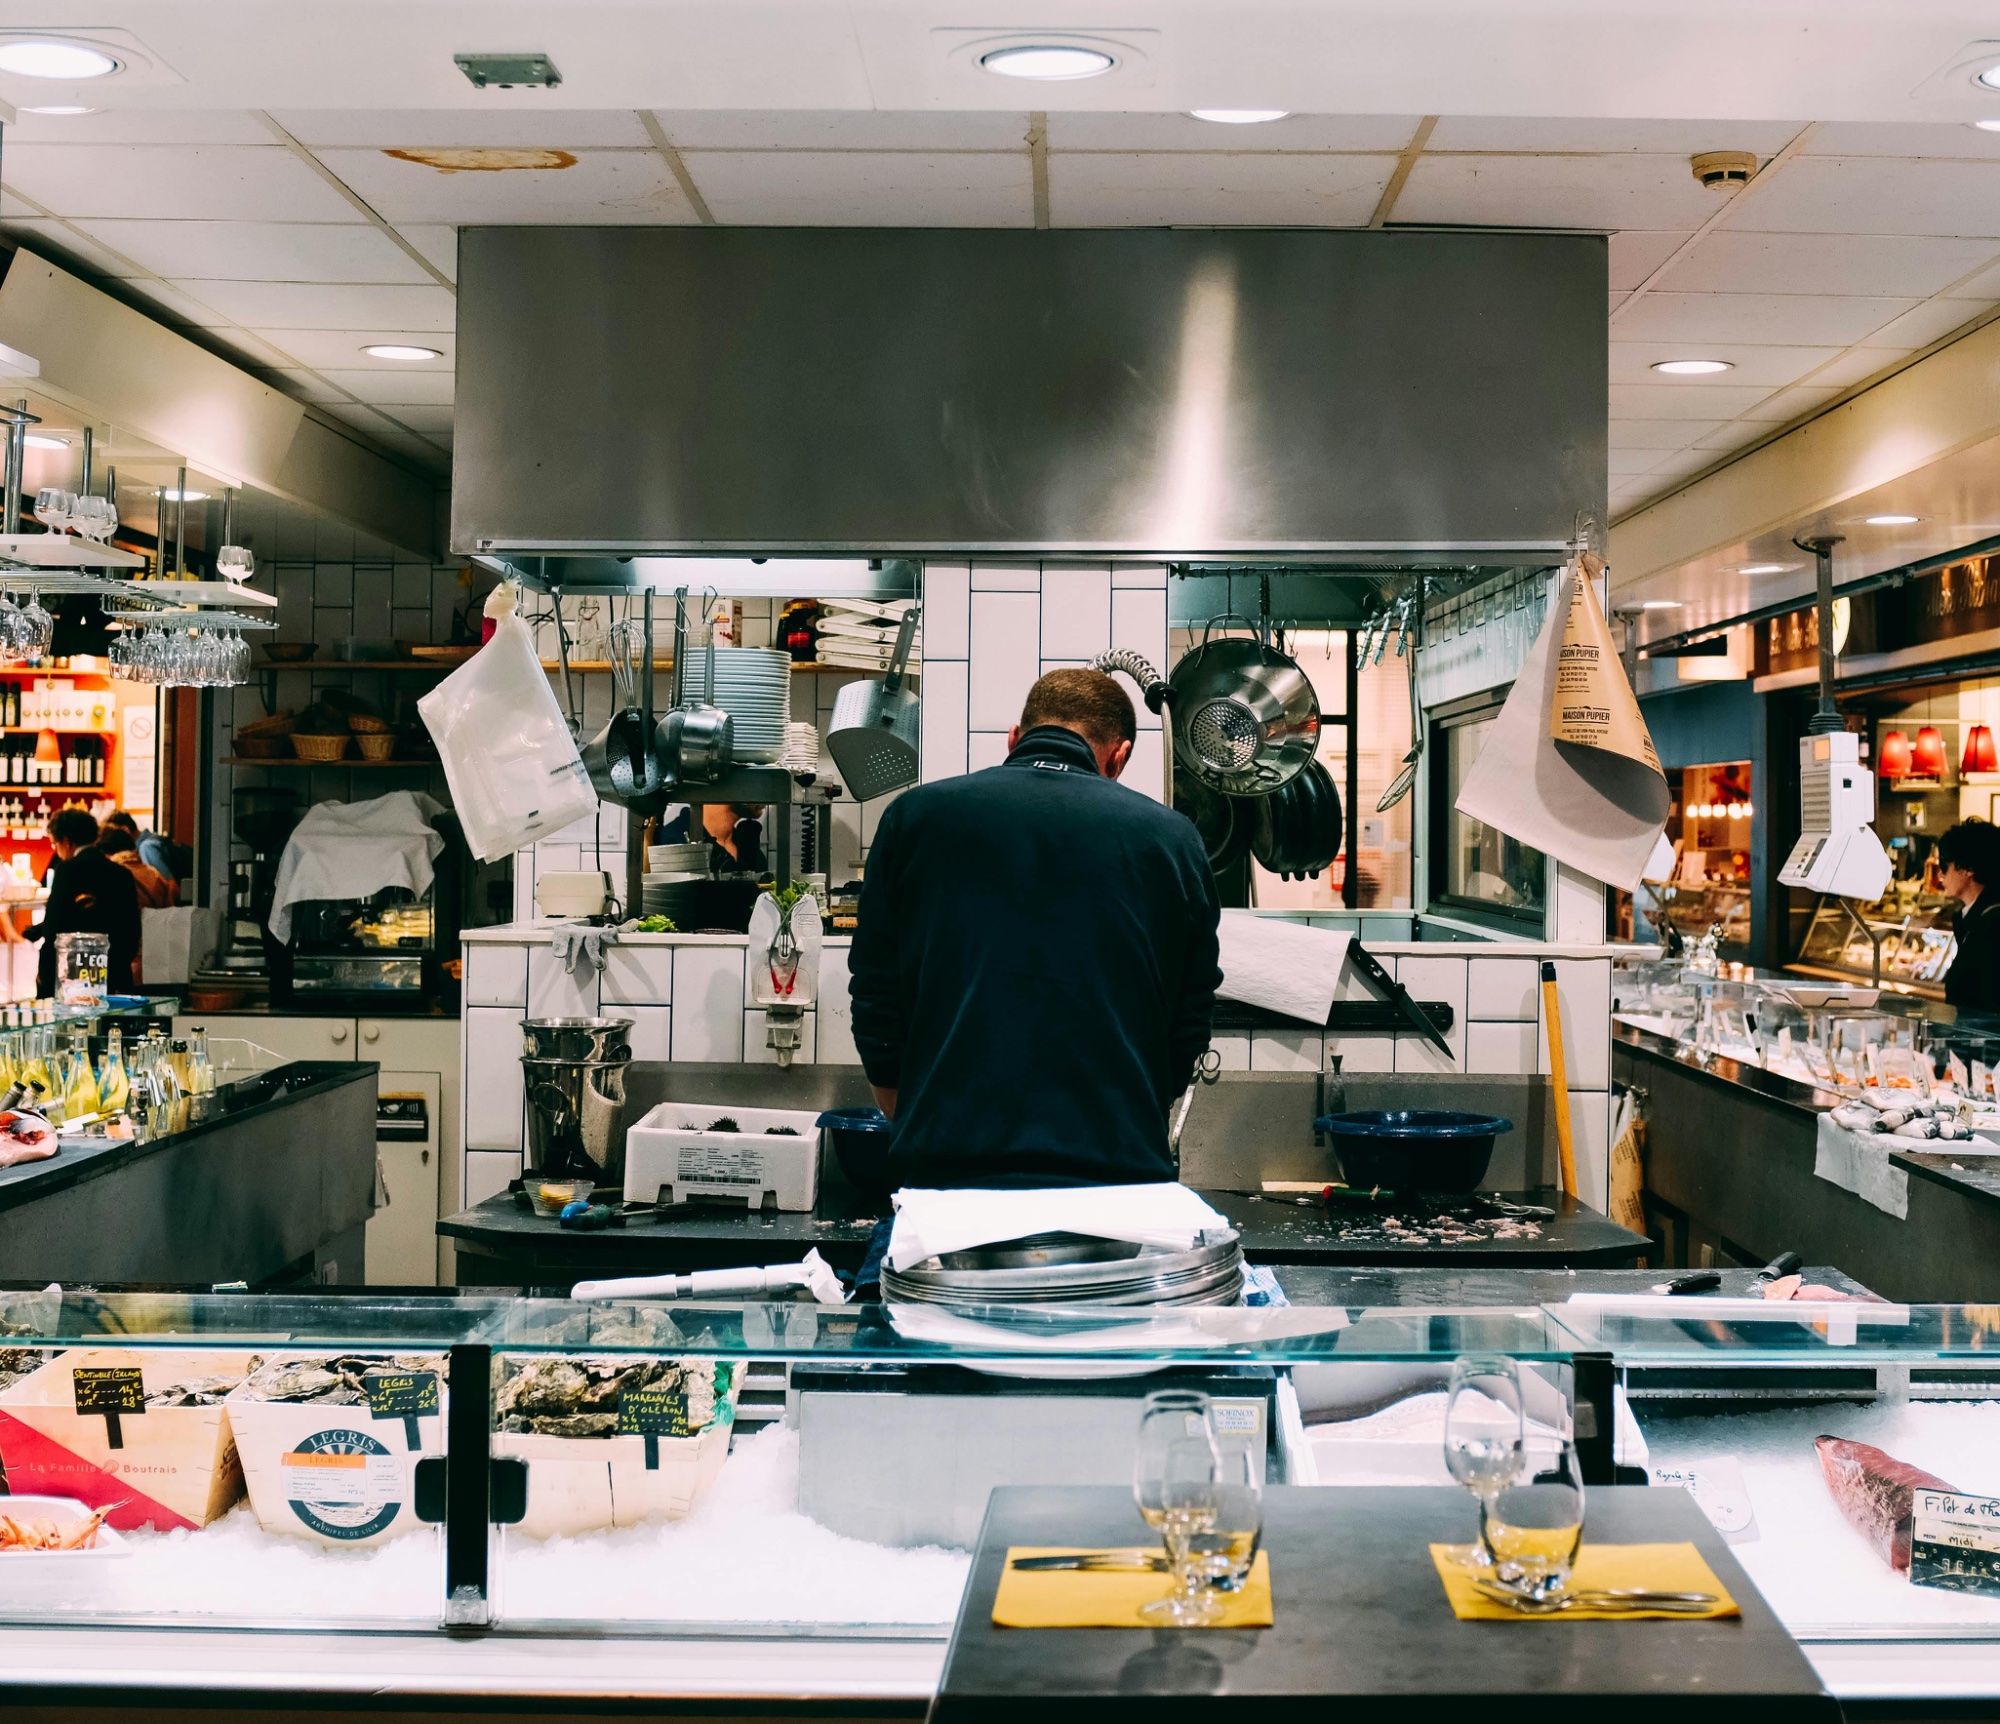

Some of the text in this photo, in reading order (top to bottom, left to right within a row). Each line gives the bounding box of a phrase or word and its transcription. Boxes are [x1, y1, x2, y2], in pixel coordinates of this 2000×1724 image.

[1576, 650, 1600, 659] PUPIER
[1562, 711, 1610, 721] MAISON PUPIER
[76, 953, 108, 969] L'EQ
[79, 968, 108, 982] PUP
[309, 1430, 377, 1451] LEGRIS
[50, 1464, 97, 1473] Famille
[123, 1465, 178, 1474] Boutrais
